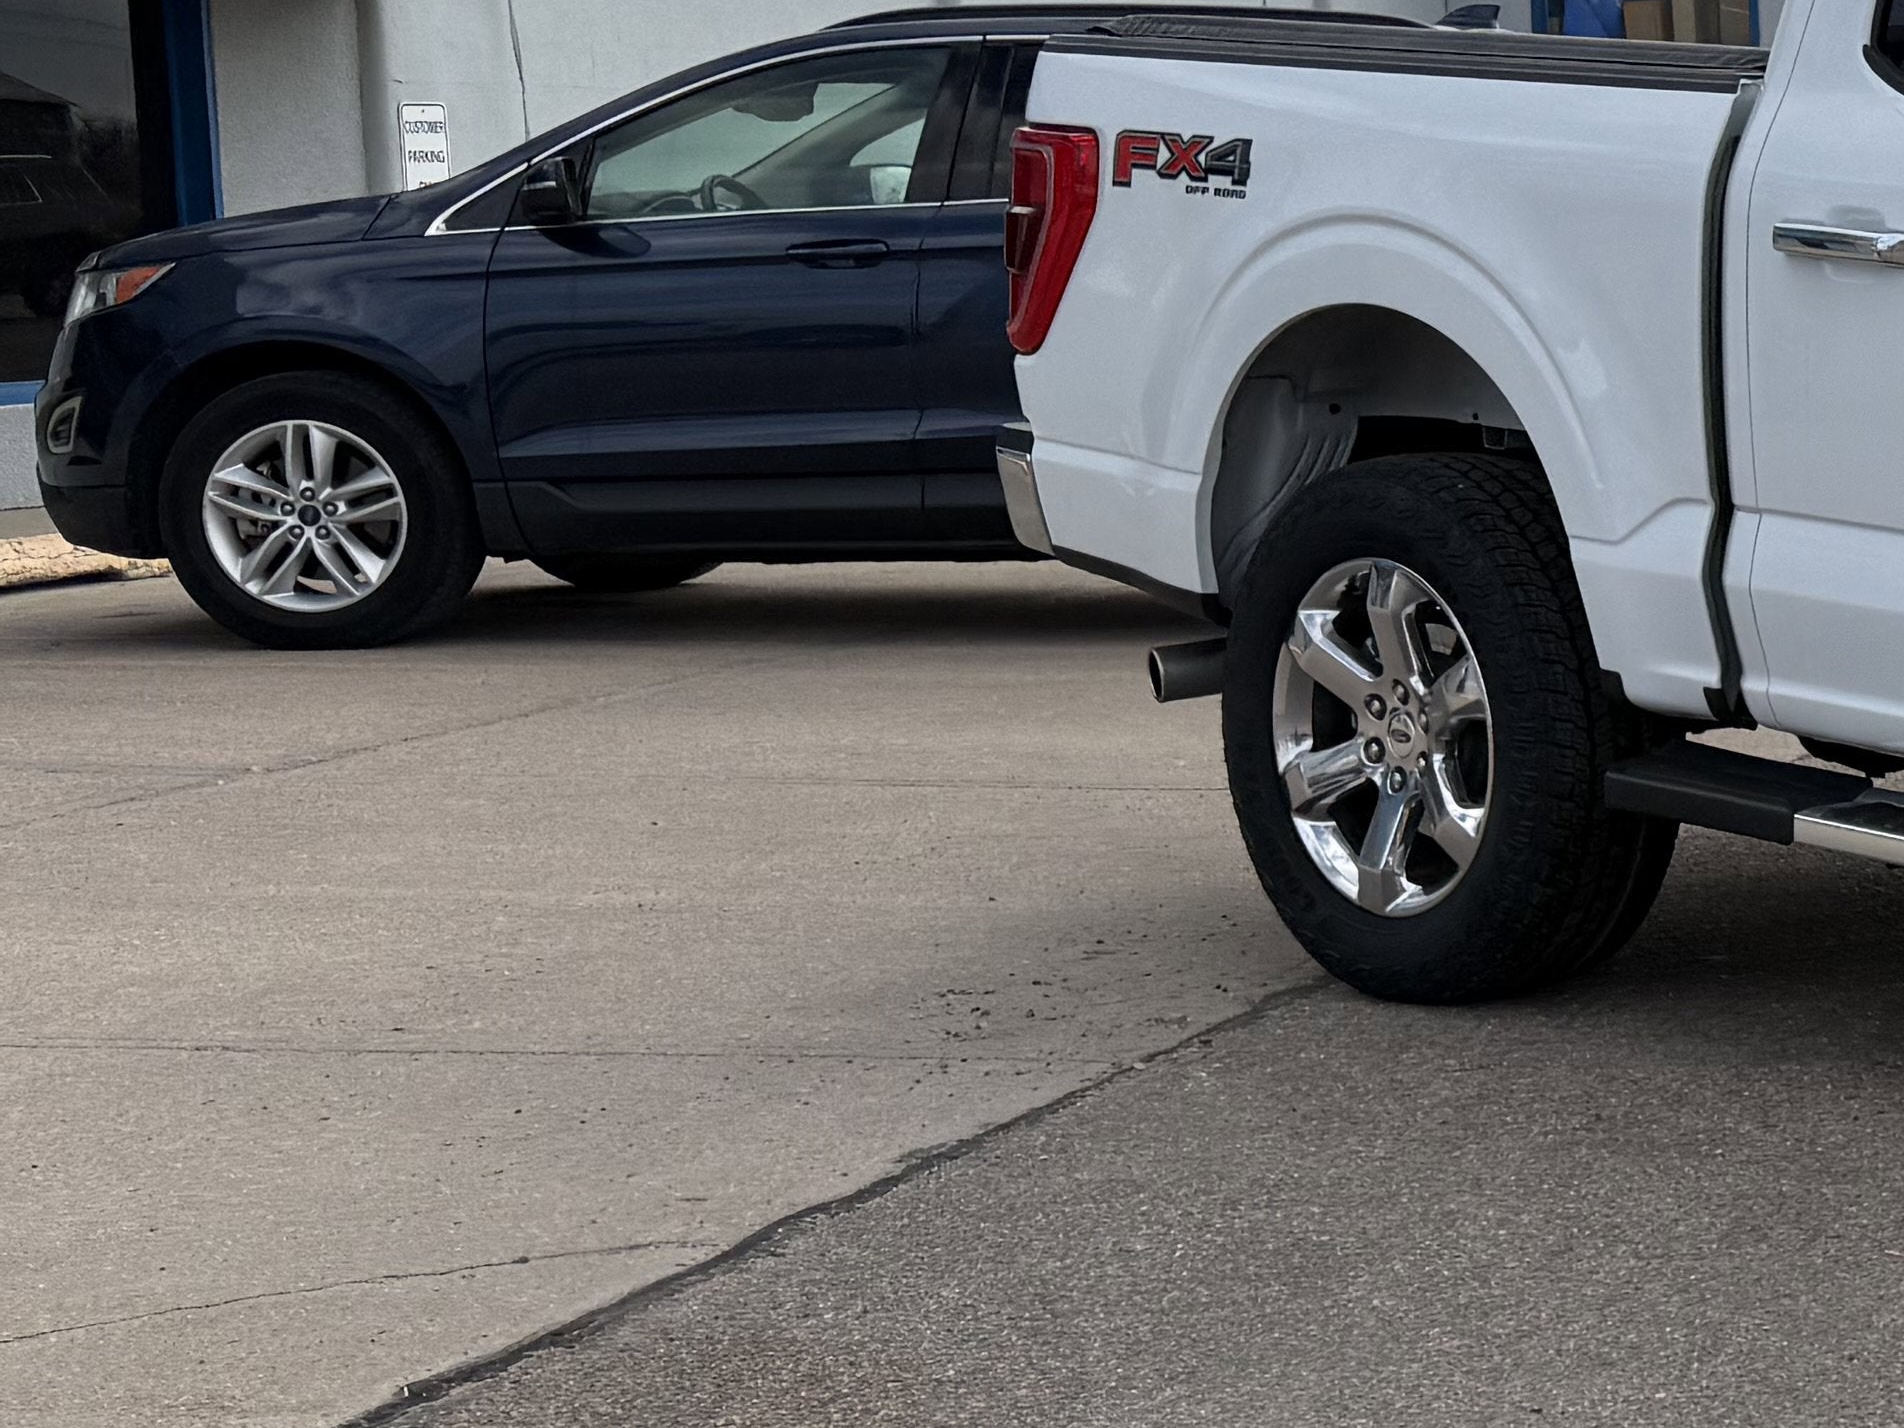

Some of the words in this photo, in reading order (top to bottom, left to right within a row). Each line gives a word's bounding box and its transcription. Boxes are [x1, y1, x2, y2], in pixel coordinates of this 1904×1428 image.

[408, 150, 446, 164] PARKING
[1112, 129, 1253, 187] FX4
[1185, 185, 1210, 196] OFF
[1213, 188, 1246, 200] ROAD
